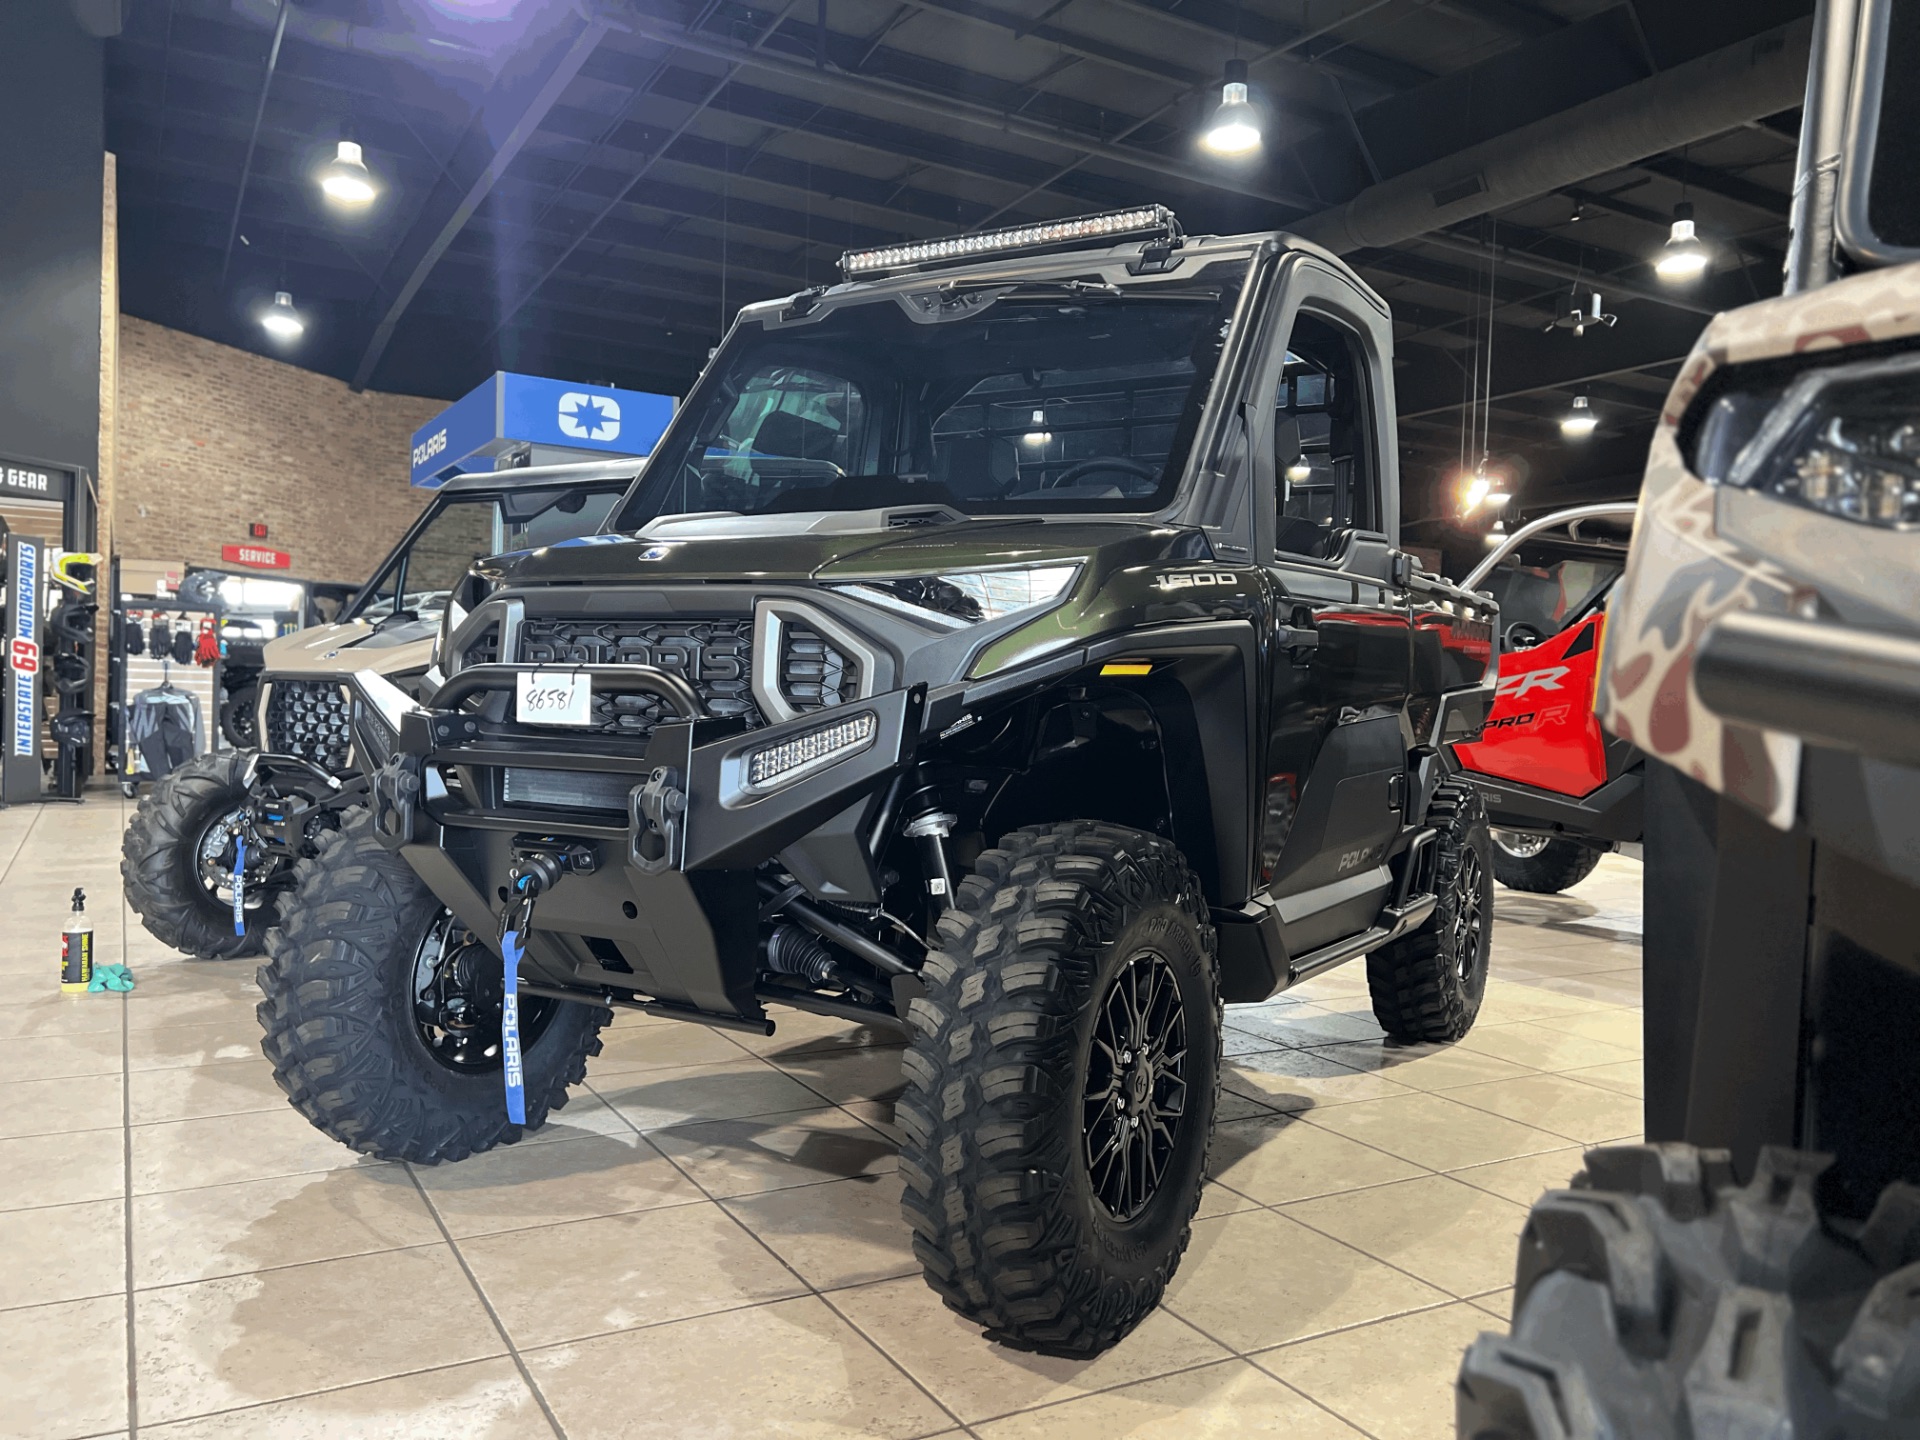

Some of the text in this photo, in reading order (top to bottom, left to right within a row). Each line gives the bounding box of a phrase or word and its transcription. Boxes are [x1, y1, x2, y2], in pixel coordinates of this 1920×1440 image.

[413, 428, 447, 469] POLARIS
[8, 468, 48, 492] GEAR
[239, 548, 276, 565] SERVICE
[13, 544, 37, 753] INTERSTATE 69 MOTORSPORTS
[525, 689, 575, 712] 86581
[1495, 665, 1571, 700] ZR
[234, 874, 243, 923] POLARIS
[505, 993, 521, 1088] POLARIS
